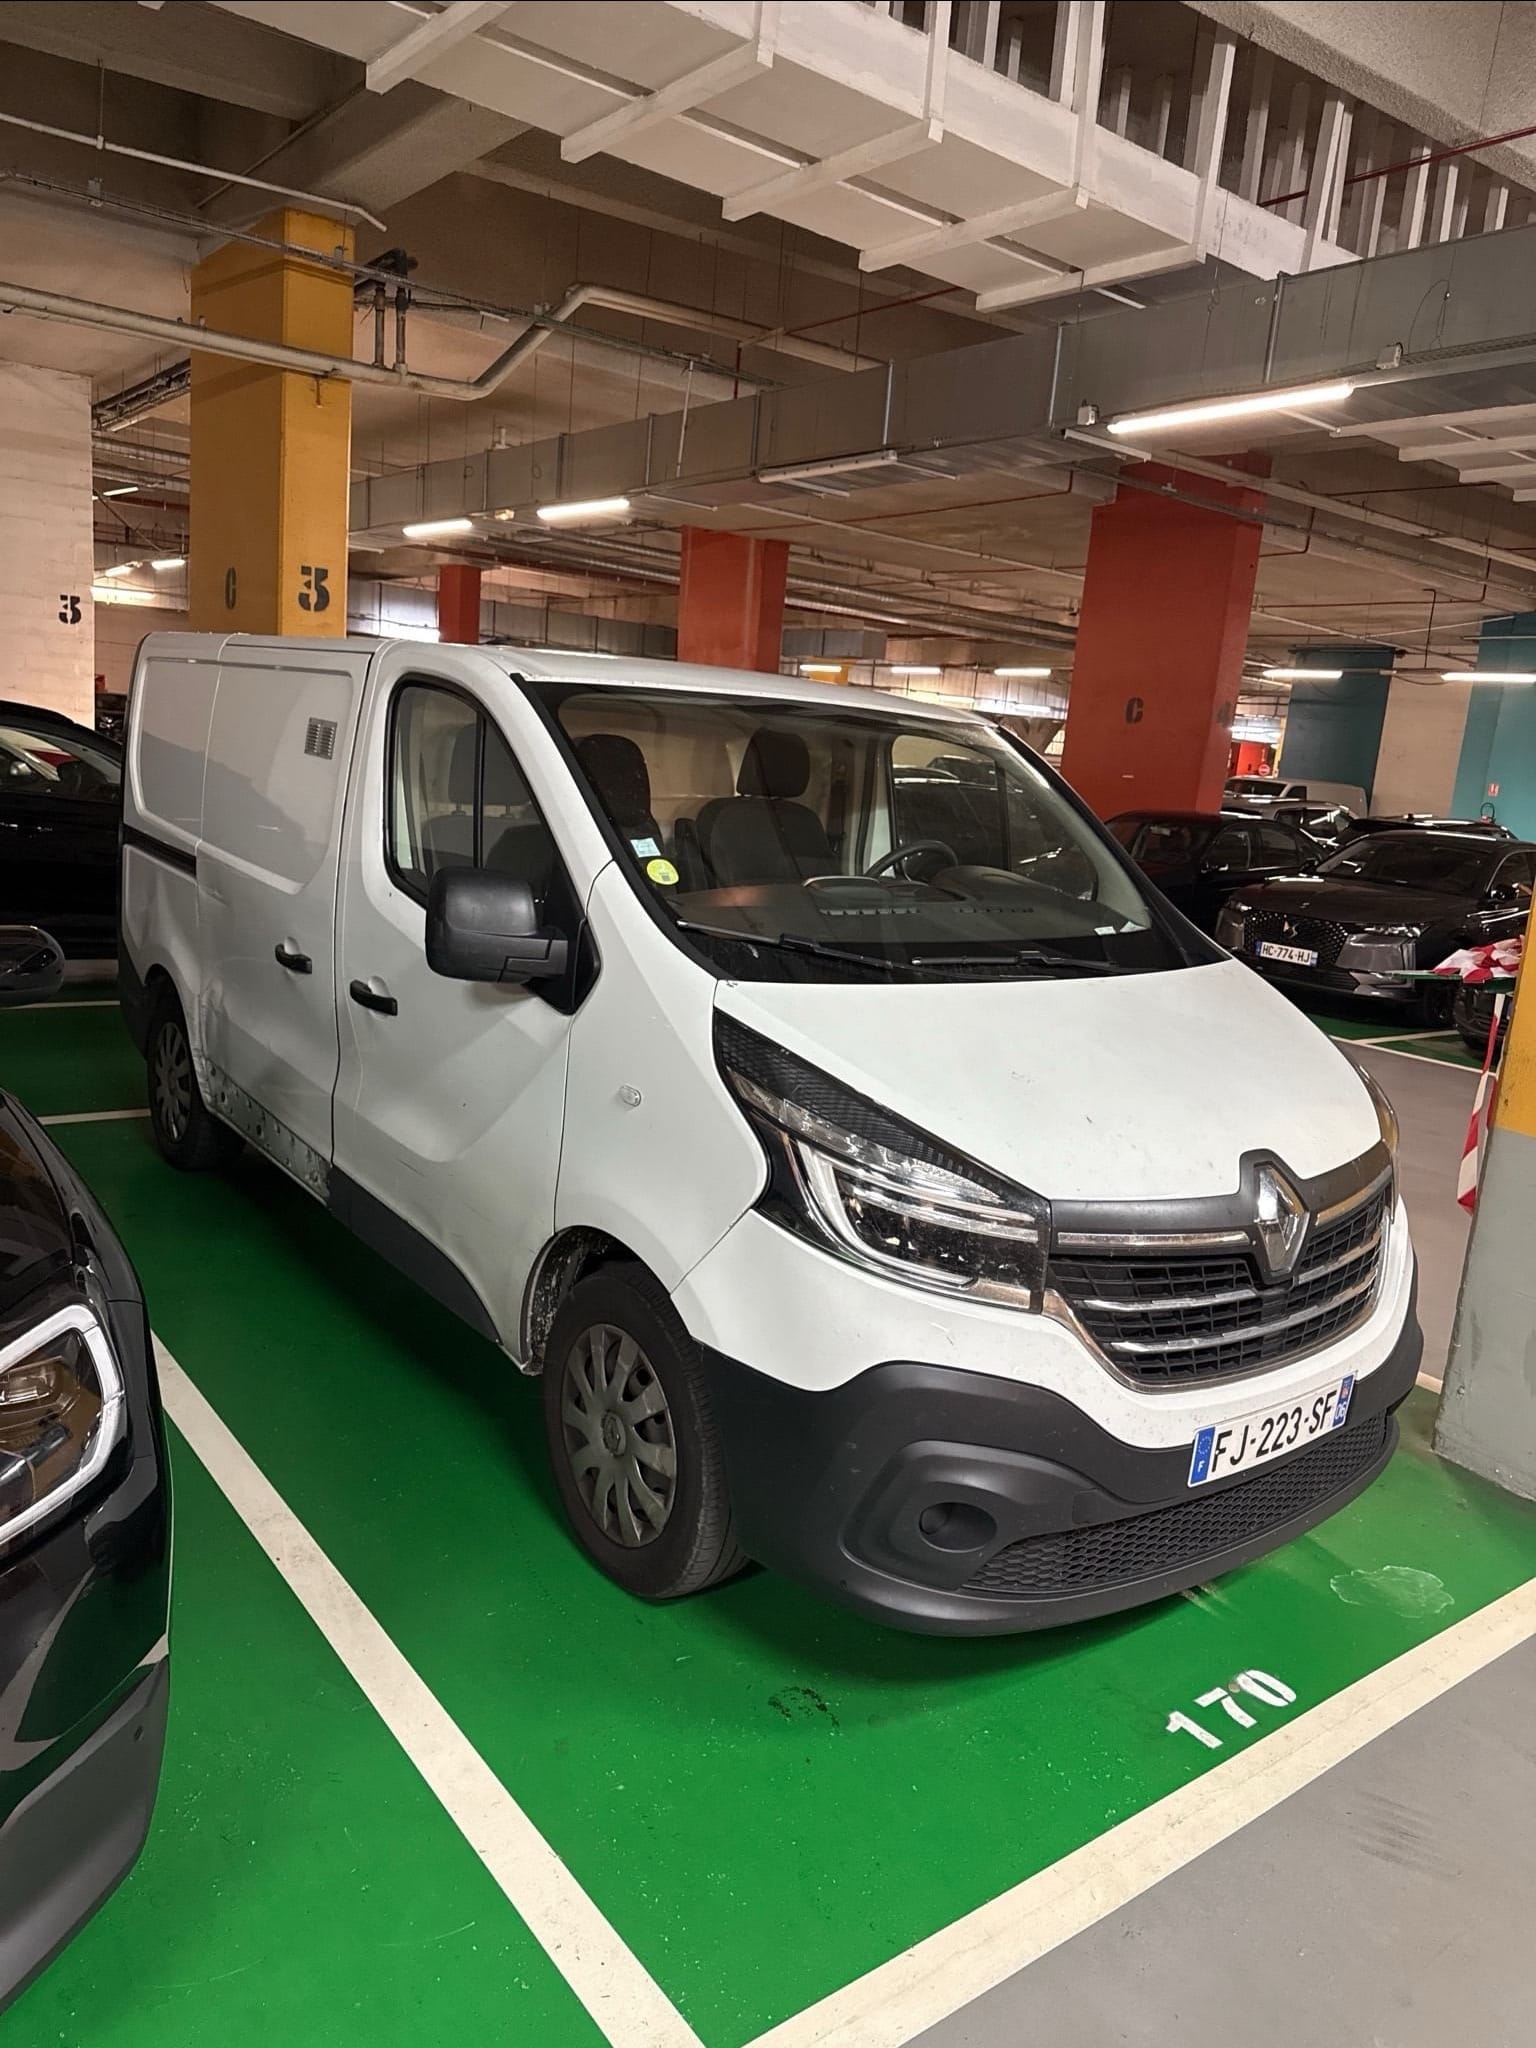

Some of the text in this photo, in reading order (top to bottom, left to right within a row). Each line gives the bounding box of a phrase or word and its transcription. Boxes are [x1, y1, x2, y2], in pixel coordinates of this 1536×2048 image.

[298, 565, 330, 612] 3
[59, 594, 82, 625] 3
[1126, 697, 1144, 724] C
[1262, 943, 1311, 963] HC-774-HJ
[1211, 1389, 1338, 1473] FJ-223-SF
[1197, 1460, 1206, 1473] F
[1165, 1669, 1297, 1749] 170
